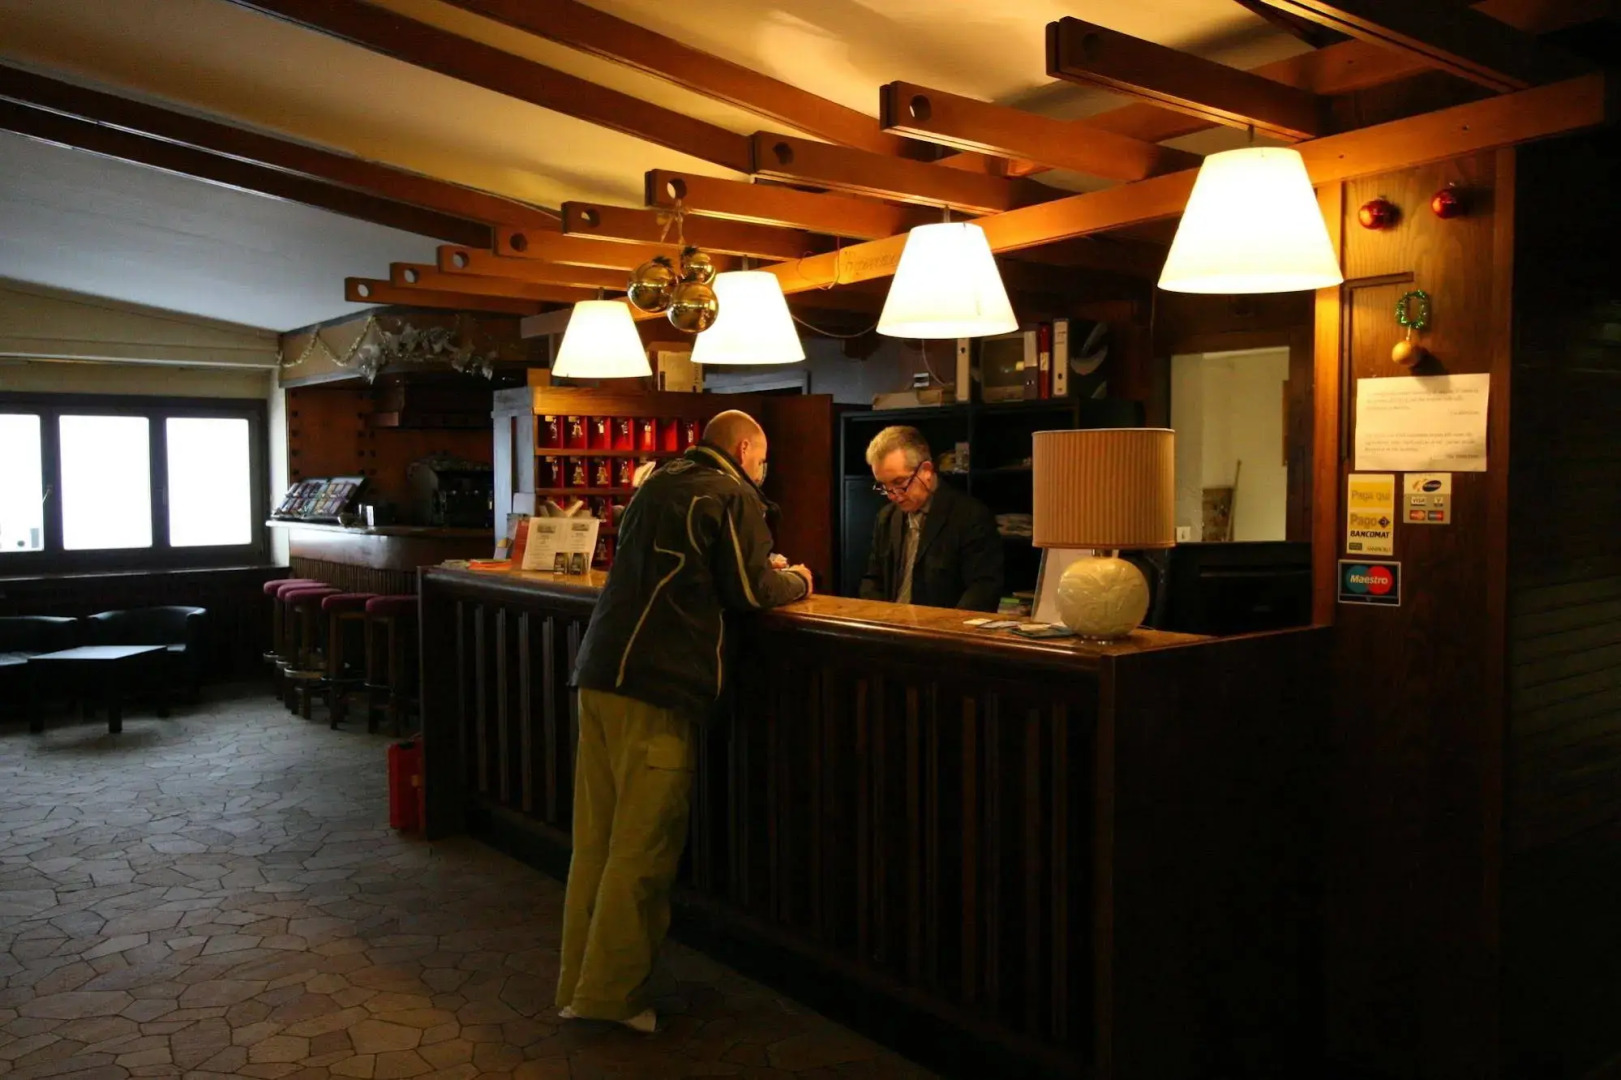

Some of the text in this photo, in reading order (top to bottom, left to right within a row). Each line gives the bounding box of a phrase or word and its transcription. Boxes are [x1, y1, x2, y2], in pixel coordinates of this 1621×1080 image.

[1350, 512, 1377, 529] Pago
[1350, 530, 1390, 539] BANCOMAT
[1350, 574, 1388, 585] Maestro
